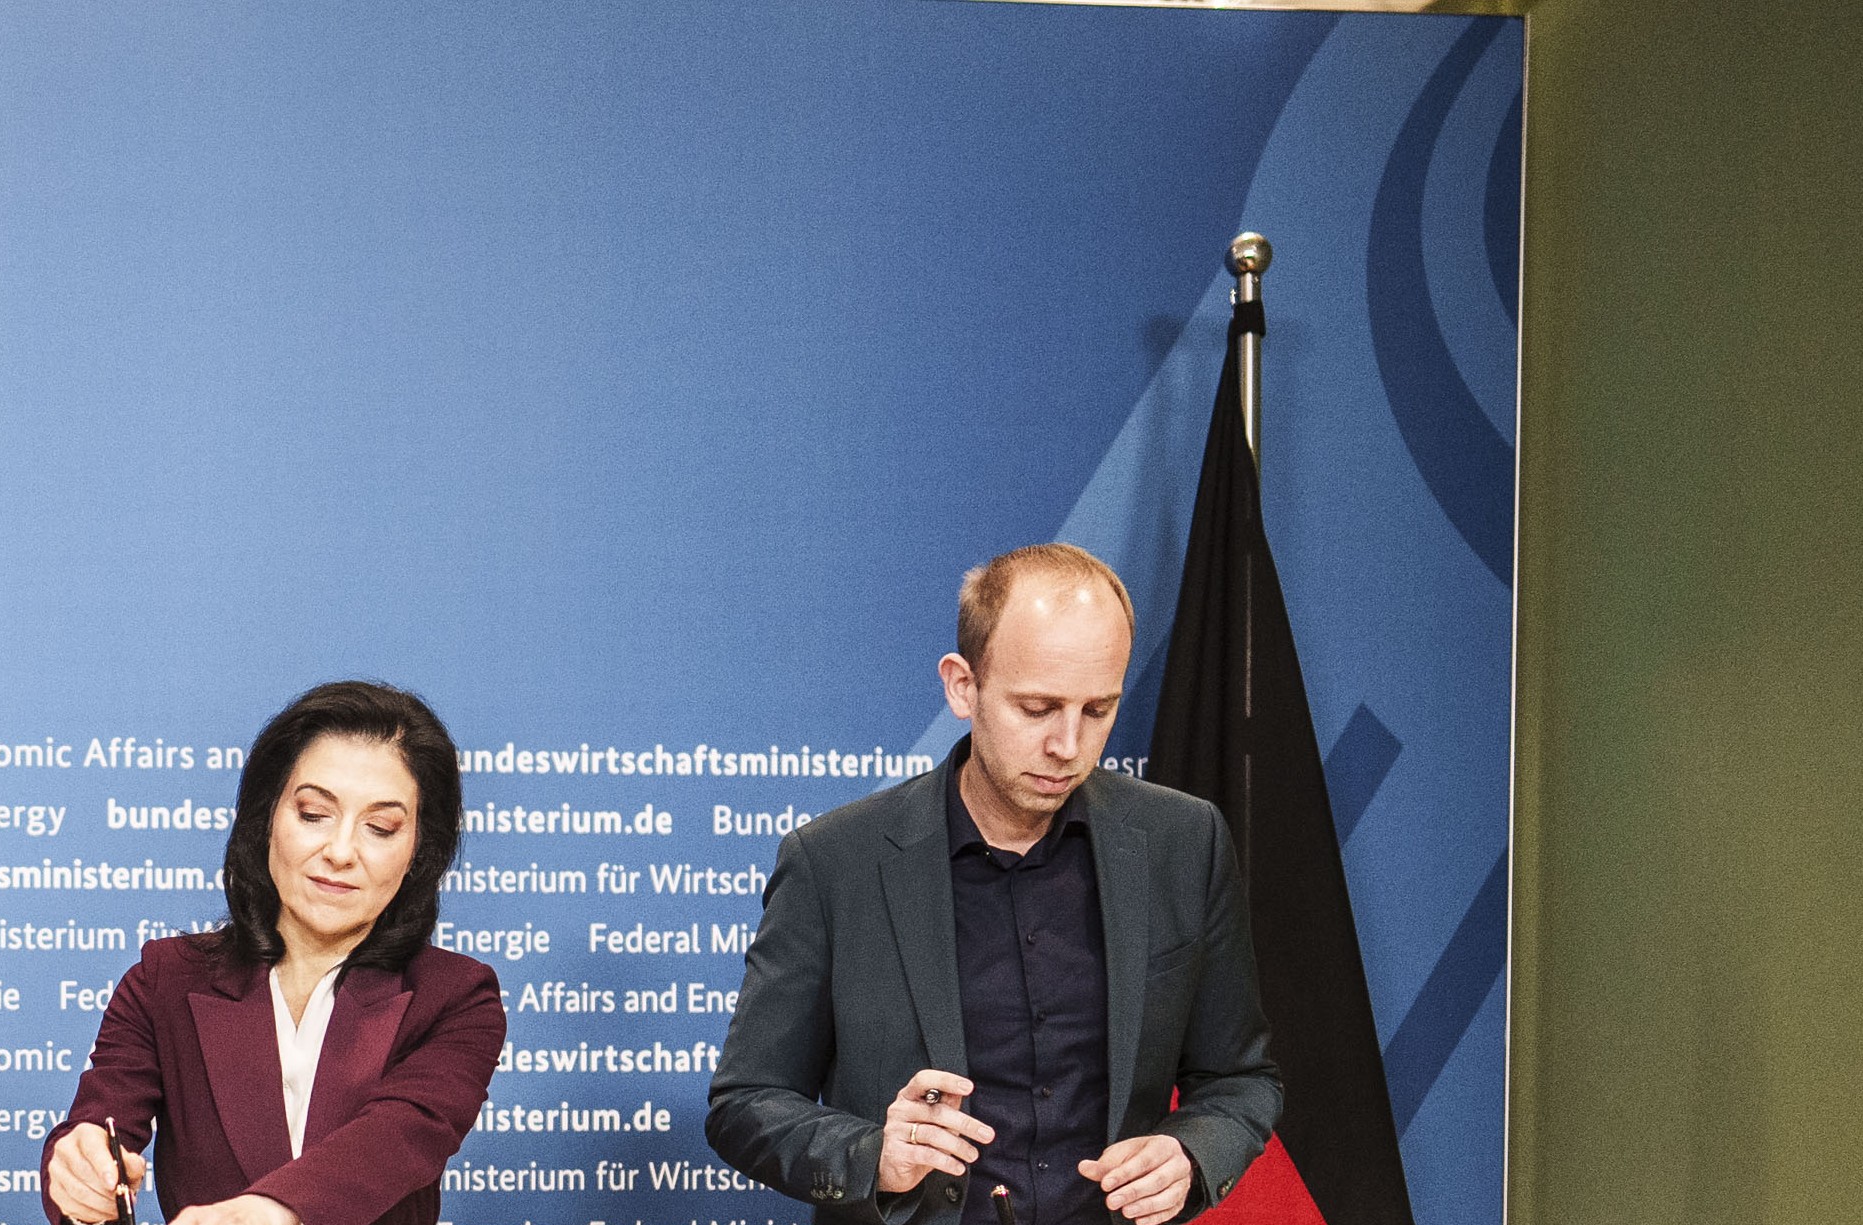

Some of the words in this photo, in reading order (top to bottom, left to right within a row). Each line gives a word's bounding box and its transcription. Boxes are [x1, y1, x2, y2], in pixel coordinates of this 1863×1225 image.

[82, 737, 196, 770] Affairs
[206, 746, 244, 770] an
[456, 742, 934, 779] undeswirtschaftsministerium
[440, 862, 588, 895] nisterium
[596, 862, 642, 895] für
[648, 863, 766, 896] Wirtsch
[437, 921, 551, 961] Energie
[588, 922, 702, 955] Federal
[516, 981, 617, 1014] Affairs
[623, 982, 679, 1014] and
[686, 982, 740, 1014] Ene
[442, 1161, 586, 1193] nisterium
[594, 1160, 640, 1192] für
